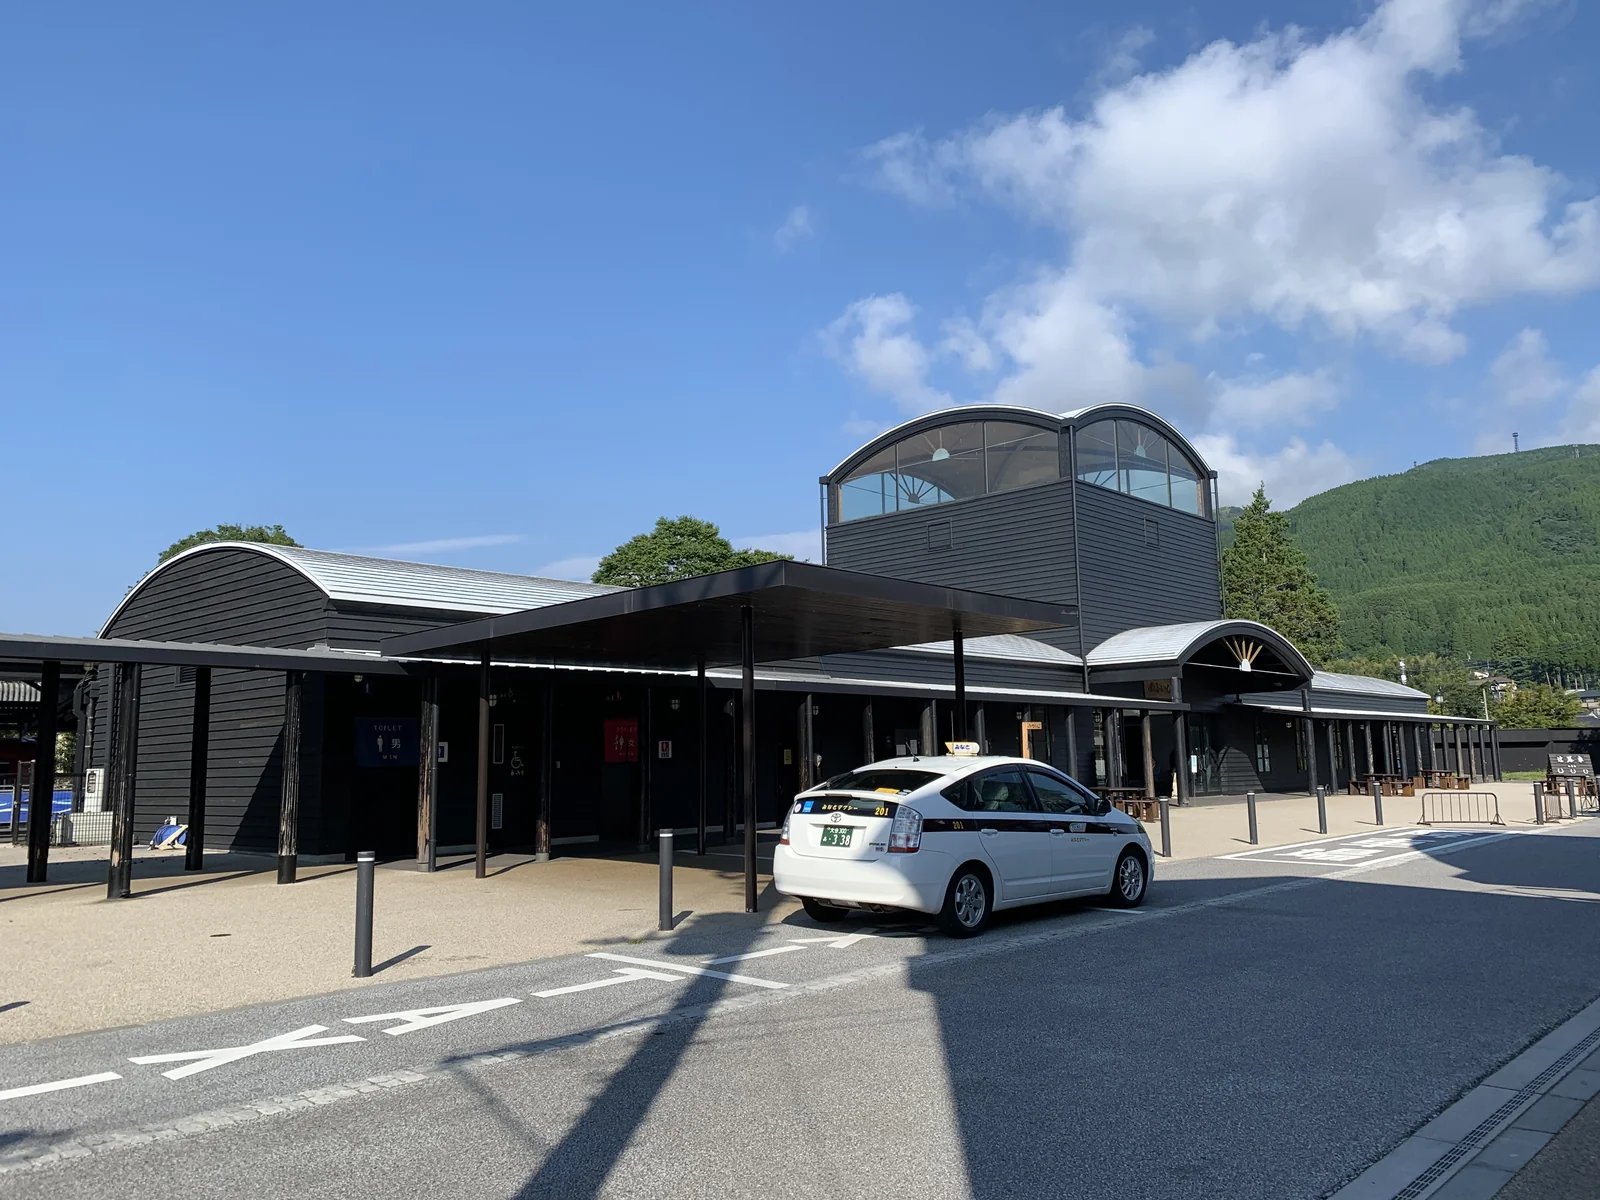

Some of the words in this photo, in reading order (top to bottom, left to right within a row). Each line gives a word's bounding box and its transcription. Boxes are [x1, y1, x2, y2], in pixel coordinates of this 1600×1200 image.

[373, 724, 402, 732] TOILET
[391, 738, 401, 749] 男
[627, 739, 636, 748] 女
[874, 806, 889, 816] 201
[952, 820, 965, 830] 201
